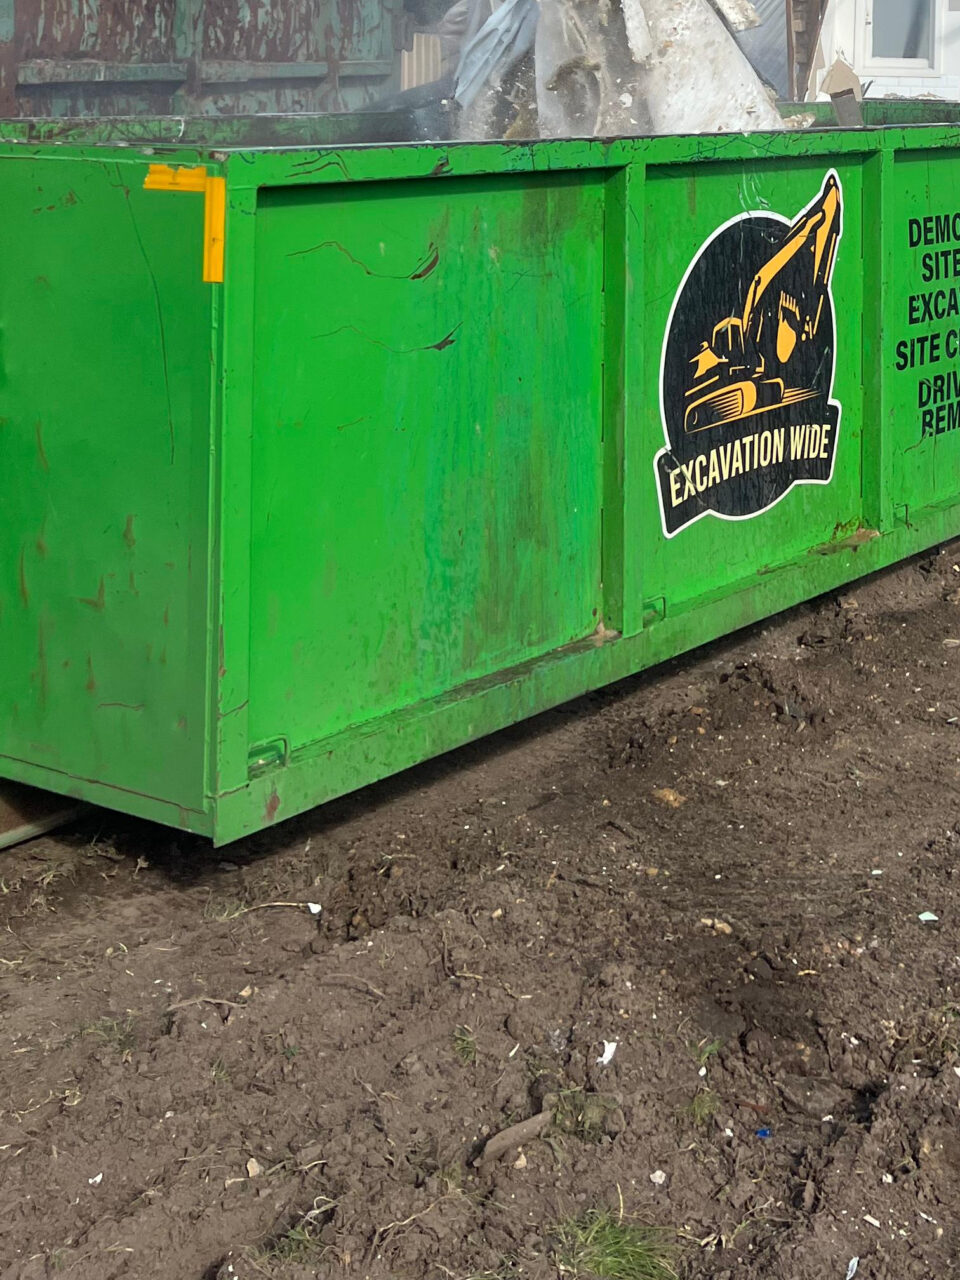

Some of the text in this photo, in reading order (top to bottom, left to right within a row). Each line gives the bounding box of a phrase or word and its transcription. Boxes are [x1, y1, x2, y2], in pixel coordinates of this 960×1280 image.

[895, 333, 940, 371] SITE
[669, 424, 831, 507] EXCAVATION WIDE
